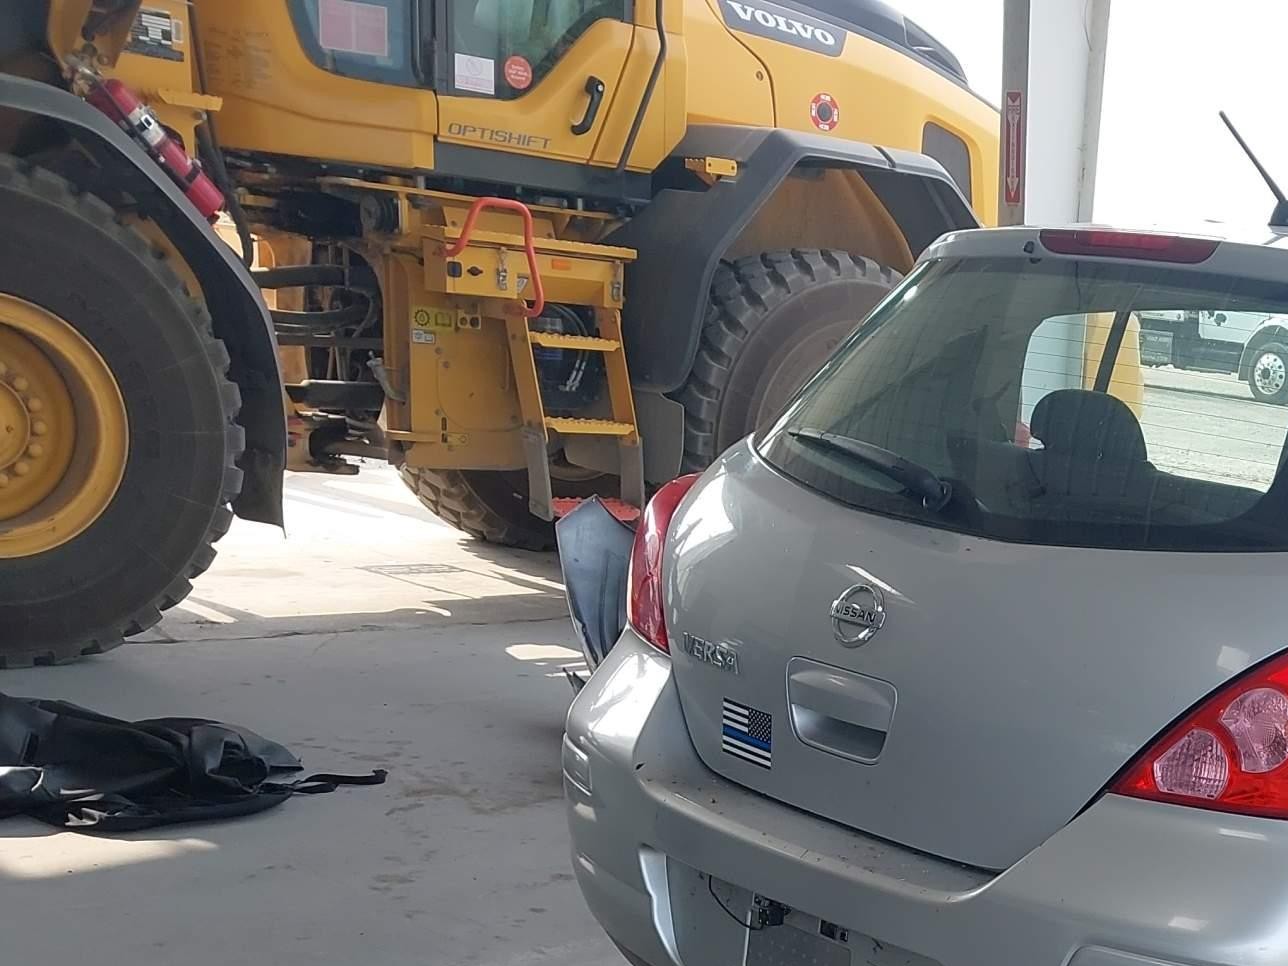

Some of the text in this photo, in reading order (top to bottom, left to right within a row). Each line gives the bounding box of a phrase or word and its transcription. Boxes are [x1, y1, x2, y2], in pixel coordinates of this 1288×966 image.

[726, 0, 835, 46] VOLVO
[448, 122, 552, 149] OPTISHIFT
[836, 603, 877, 623] NISSAN
[682, 631, 740, 675] VERSA
